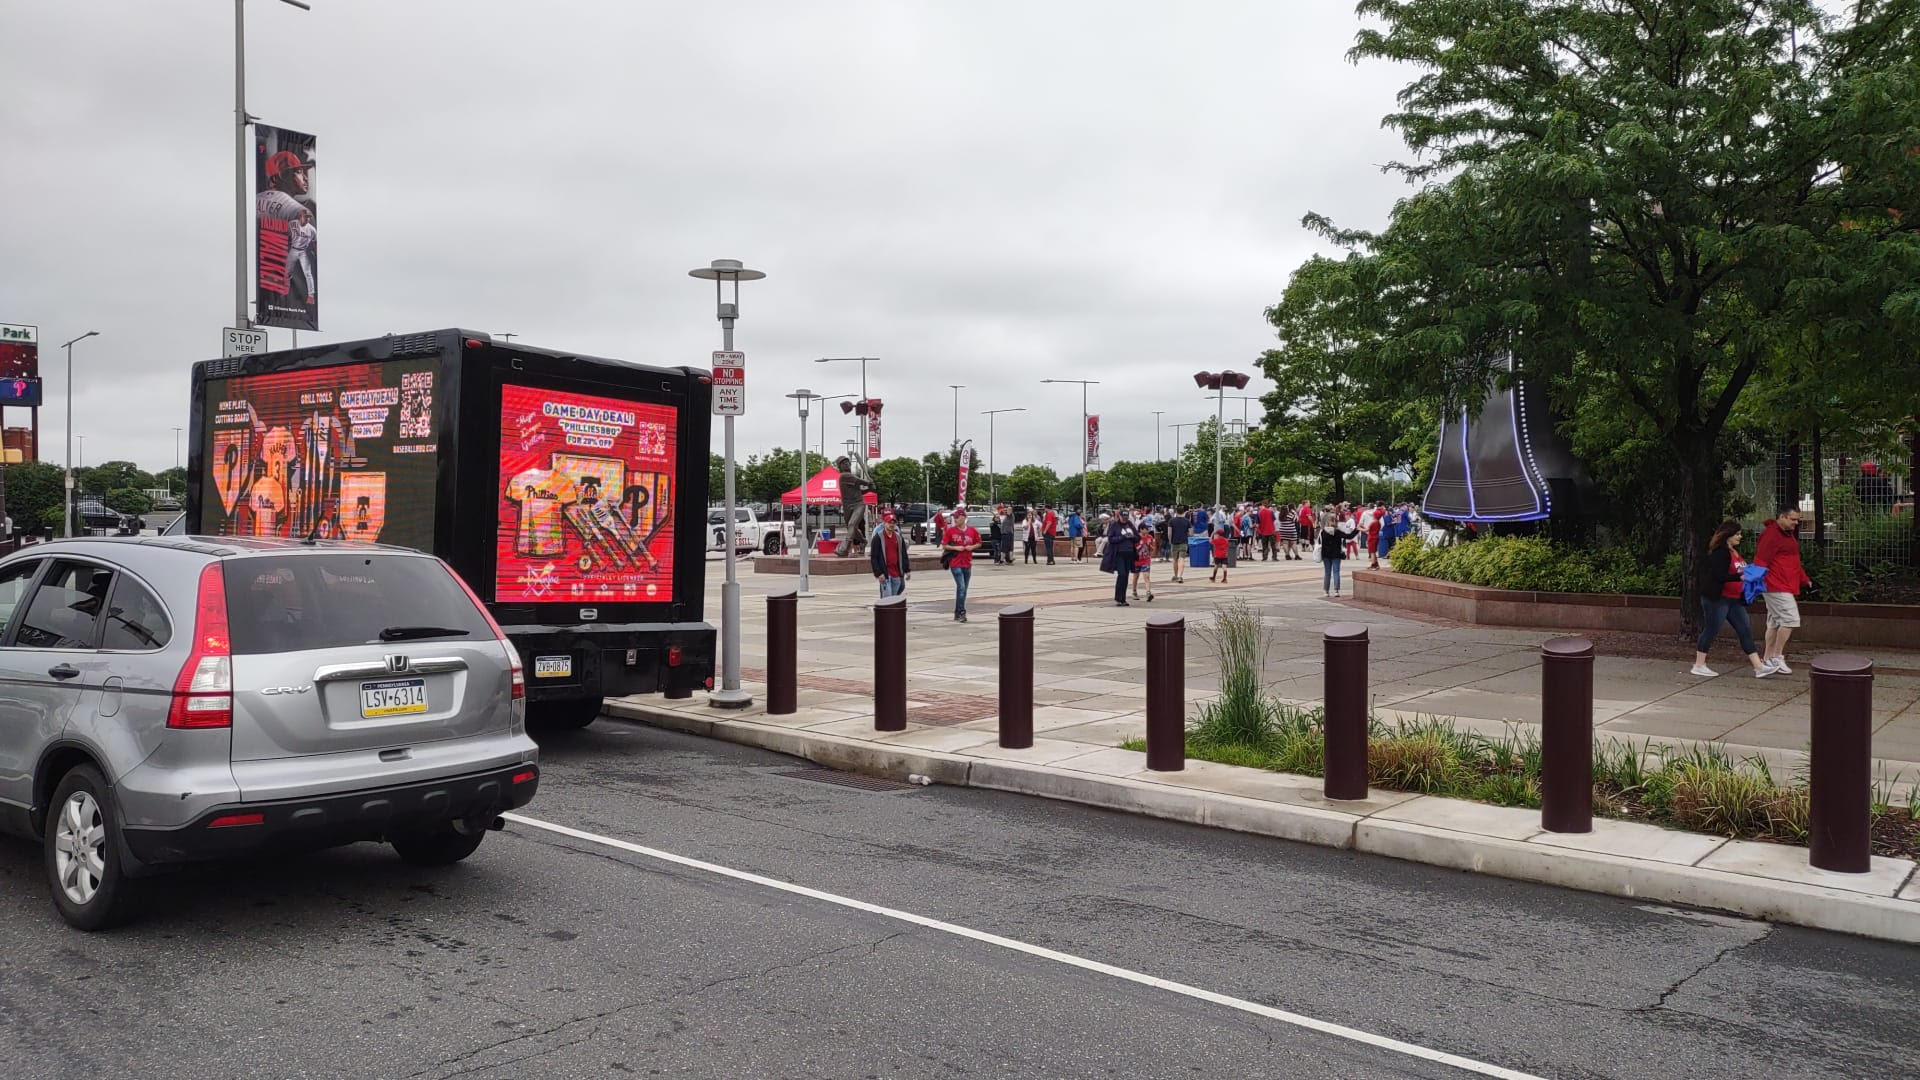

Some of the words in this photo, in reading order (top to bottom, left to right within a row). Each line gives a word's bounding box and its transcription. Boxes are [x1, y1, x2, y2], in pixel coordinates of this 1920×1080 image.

[2, 327, 31, 339] Park
[230, 332, 261, 344] STOP
[723, 368, 734, 378] NO
[316, 392, 332, 403] TOOLS
[232, 400, 246, 409] PLATE
[215, 414, 233, 424] CUTTING
[234, 413, 249, 422] BOARD
[543, 402, 577, 418] GAME
[579, 407, 600, 420] DAY
[602, 410, 635, 426] DEAL!
[567, 433, 582, 446] FOR
[260, 686, 312, 695] CR-V
